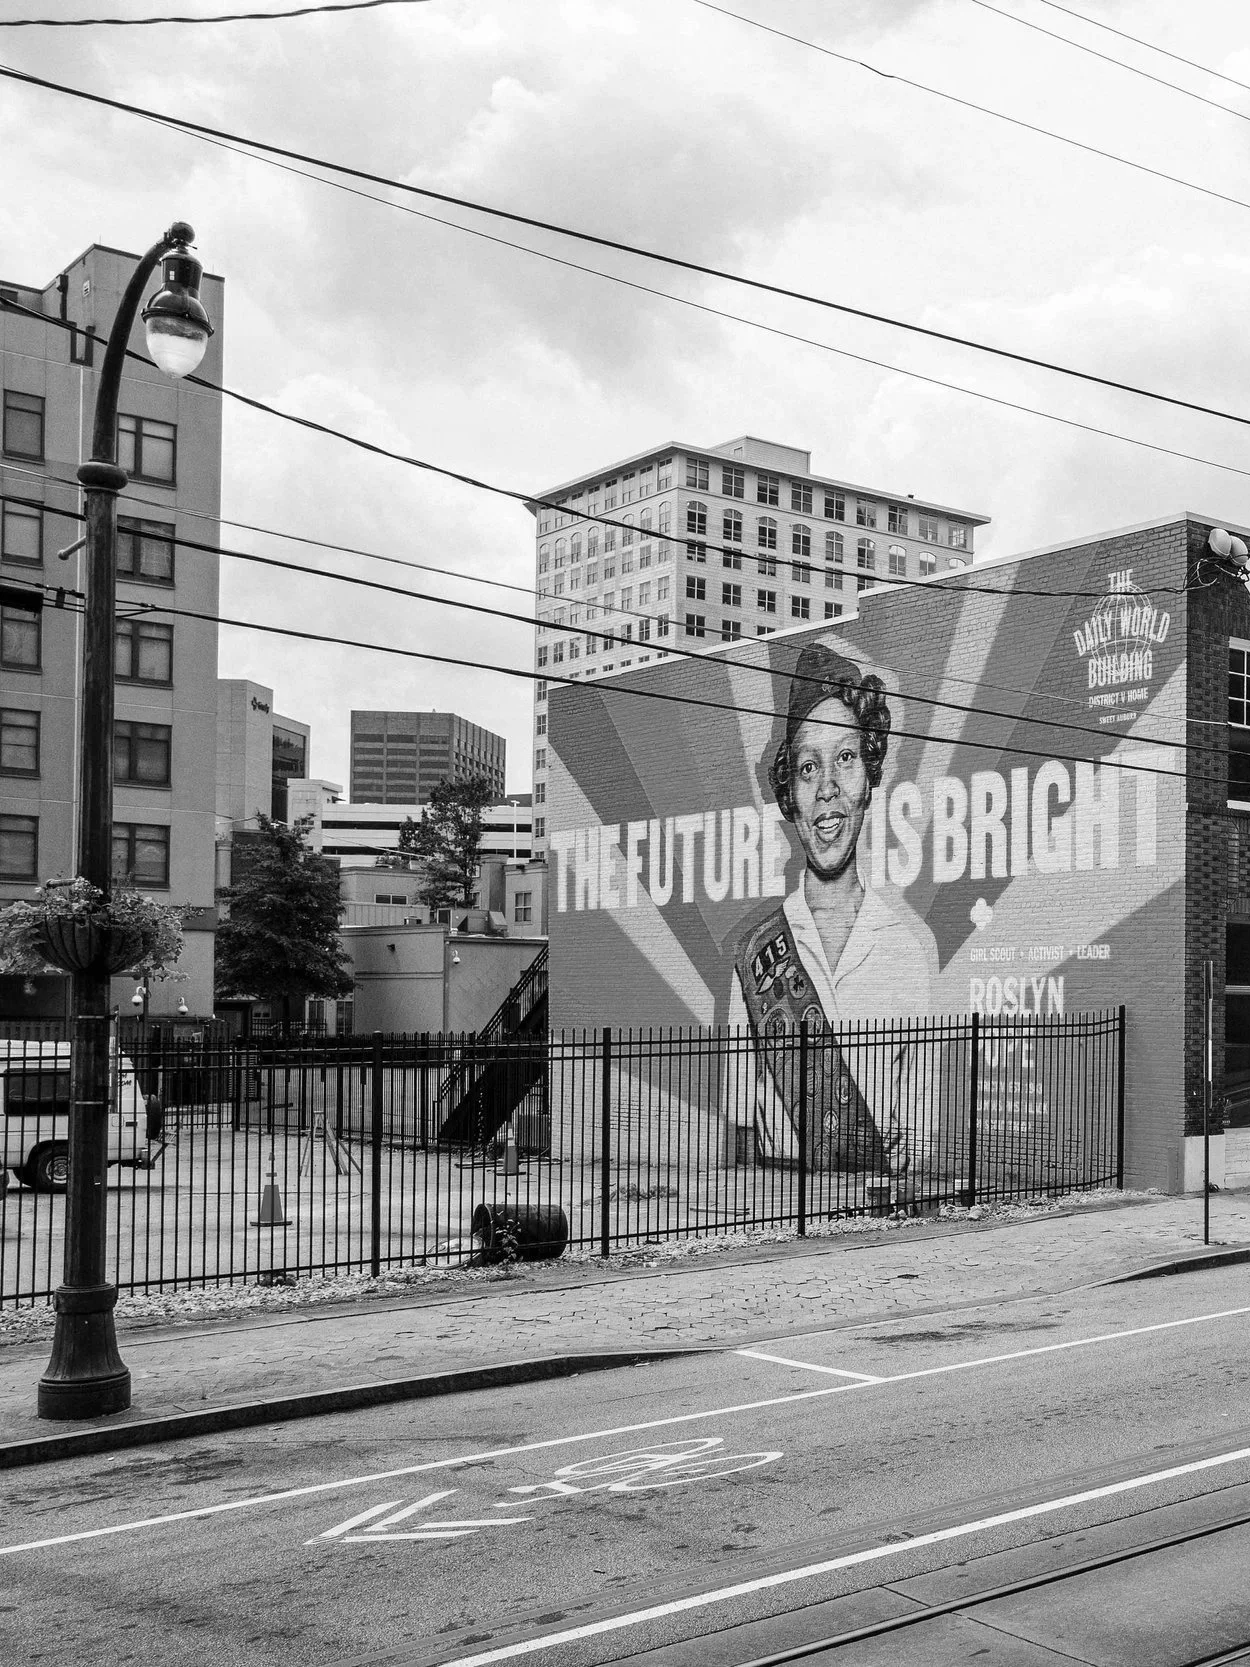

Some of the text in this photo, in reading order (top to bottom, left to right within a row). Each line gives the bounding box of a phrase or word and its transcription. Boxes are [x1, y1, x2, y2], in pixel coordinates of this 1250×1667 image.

[1108, 569, 1133, 597] THE
[1073, 606, 1170, 656] DAILY WORLD
[1088, 650, 1152, 688] BUILDING
[1089, 692, 1119, 708] DISTRICT
[1127, 687, 1148, 702] HOME
[549, 748, 1175, 912] THE FUTURE IS BRIGHT
[755, 934, 787, 977] 415
[970, 944, 1111, 962] GIRL SCOUT ACTIVIST LEADER
[970, 976, 1064, 1018] ROSLYN
